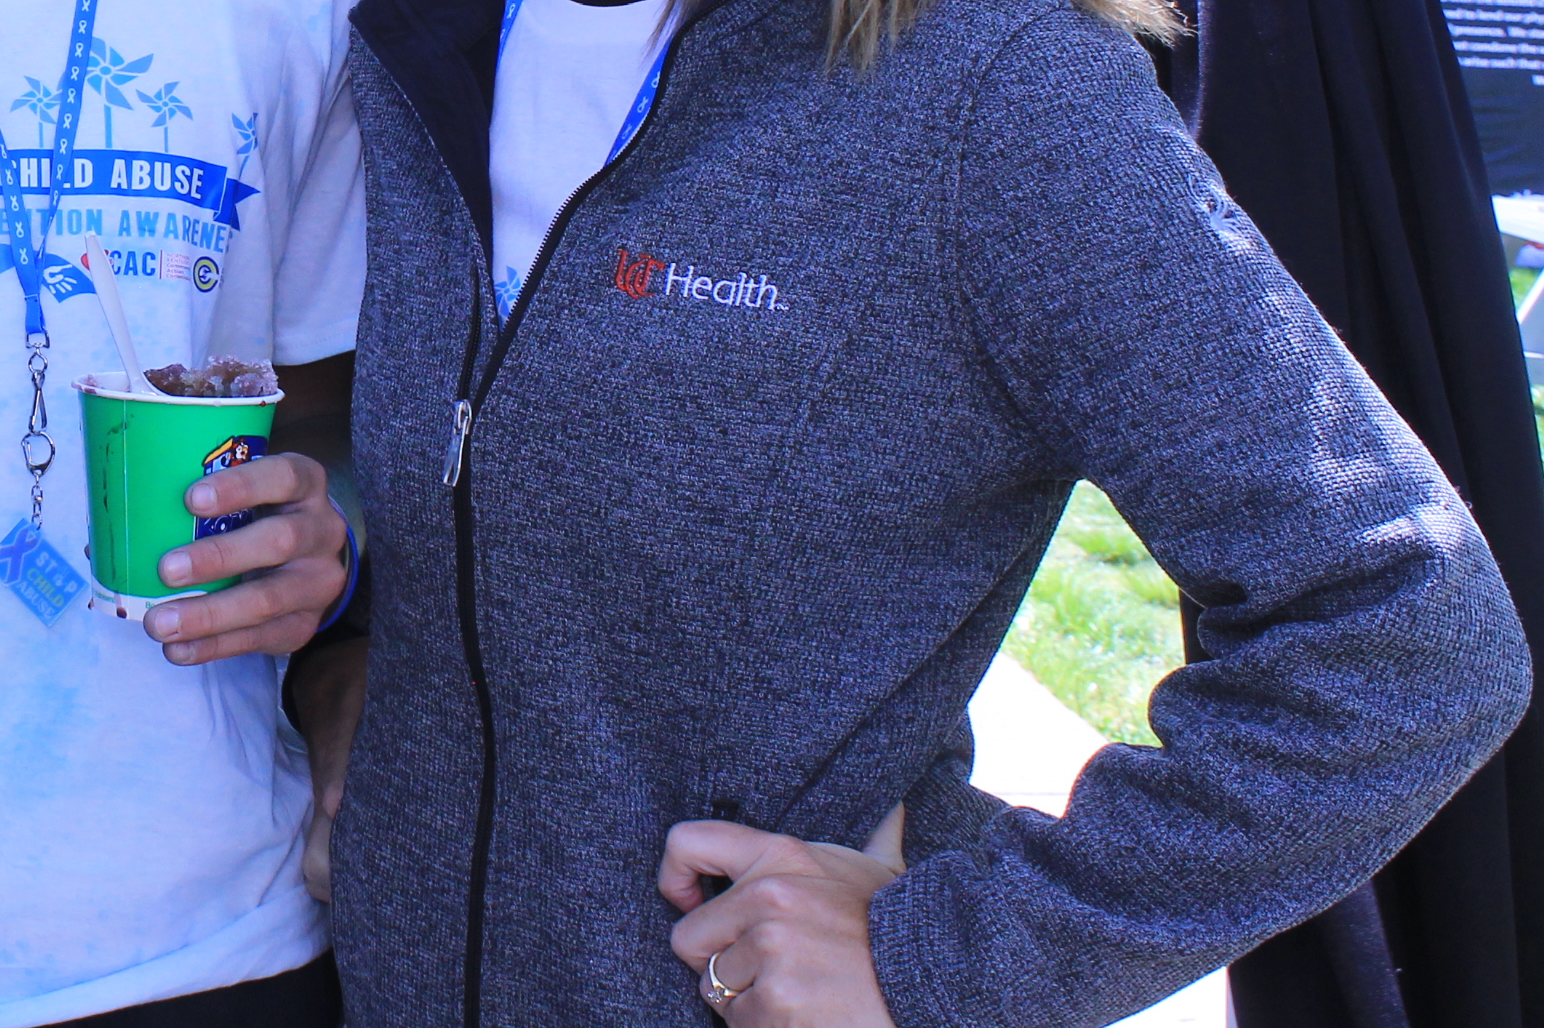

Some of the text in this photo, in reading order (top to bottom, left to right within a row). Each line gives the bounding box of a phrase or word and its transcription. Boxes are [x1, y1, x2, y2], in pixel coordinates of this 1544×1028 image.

[110, 158, 204, 200] ABUSE
[109, 250, 156, 277] CAC
[664, 262, 779, 312] Health
